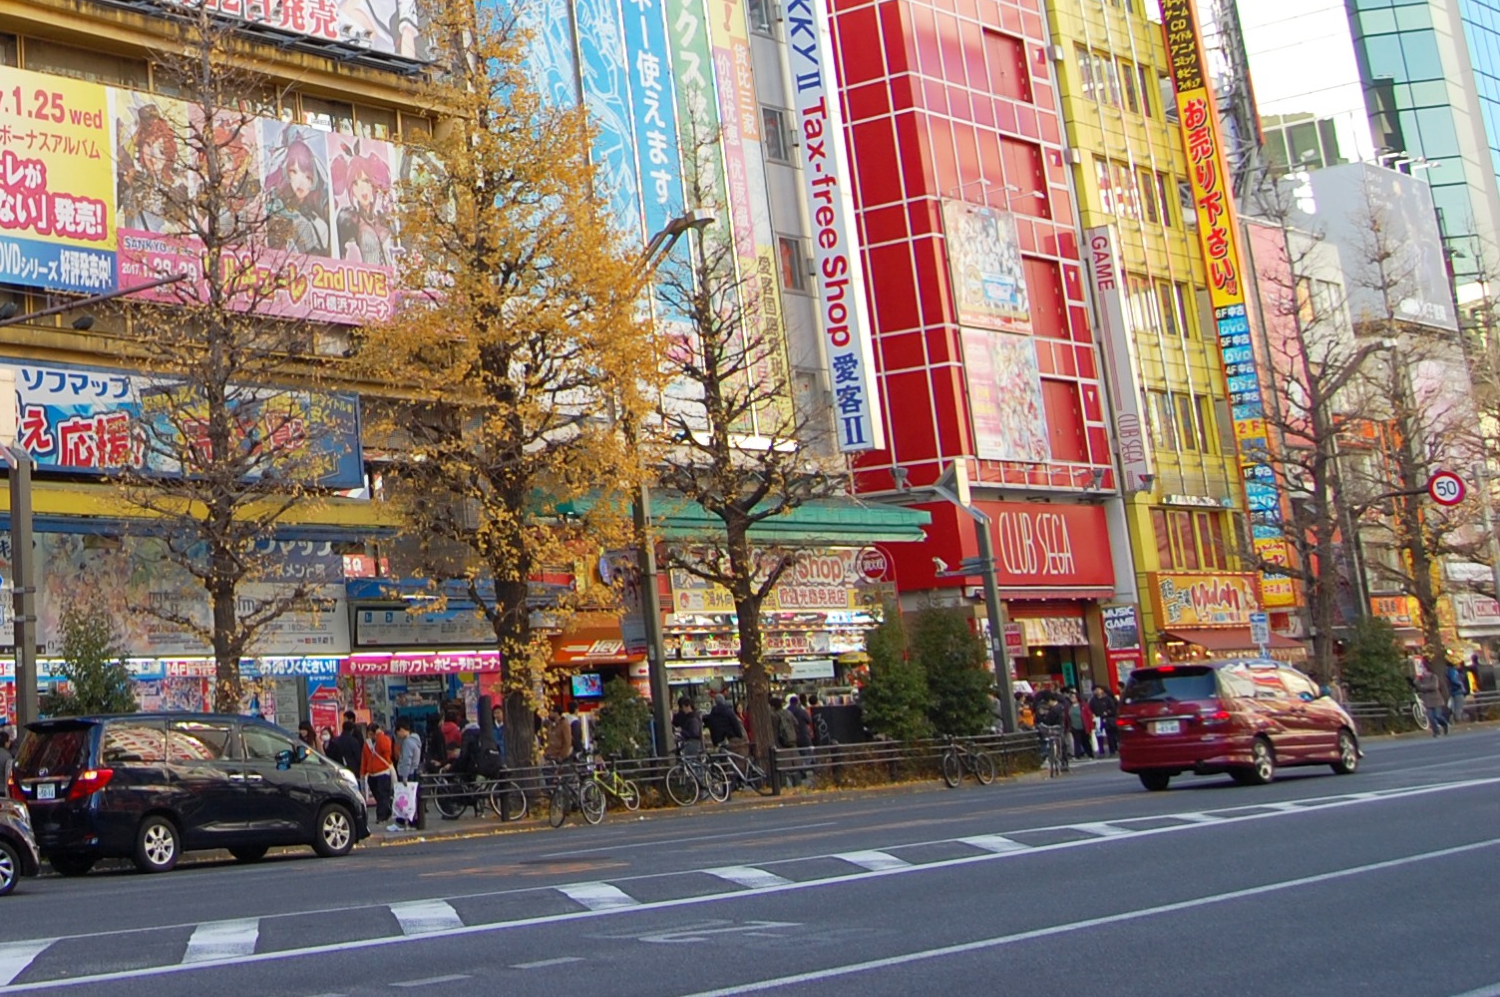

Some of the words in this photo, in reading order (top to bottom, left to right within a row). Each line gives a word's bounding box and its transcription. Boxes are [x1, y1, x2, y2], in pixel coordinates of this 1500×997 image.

[1164, 6, 1189, 21] ゲーム
[1170, 19, 1187, 32] CD
[1171, 42, 1196, 56] アニメ
[69, 108, 103, 130] wed
[0, 124, 101, 160] ボーナスアルバム
[802, 97, 838, 250] Tax-free
[821, 255, 851, 348] Shop
[60, 248, 112, 290] 好評発売中!
[1090, 235, 1117, 293] GAME
[312, 264, 345, 293] 2nd
[349, 268, 388, 297] LIVE
[1220, 322, 1246, 335] DVD
[21, 368, 130, 399] ソフマップ
[1117, 413, 1140, 439] CLUB
[1121, 439, 1144, 465] SEGA
[1435, 481, 1457, 498] 50
[999, 511, 1038, 575] CLUB
[1035, 512, 1076, 575] SEGA
[799, 554, 843, 585] Shop
[1102, 605, 1135, 617] MUSIC
[1190, 577, 1241, 622] Mulan
[1104, 616, 1137, 629] GAME
[588, 639, 623, 654] Hey
